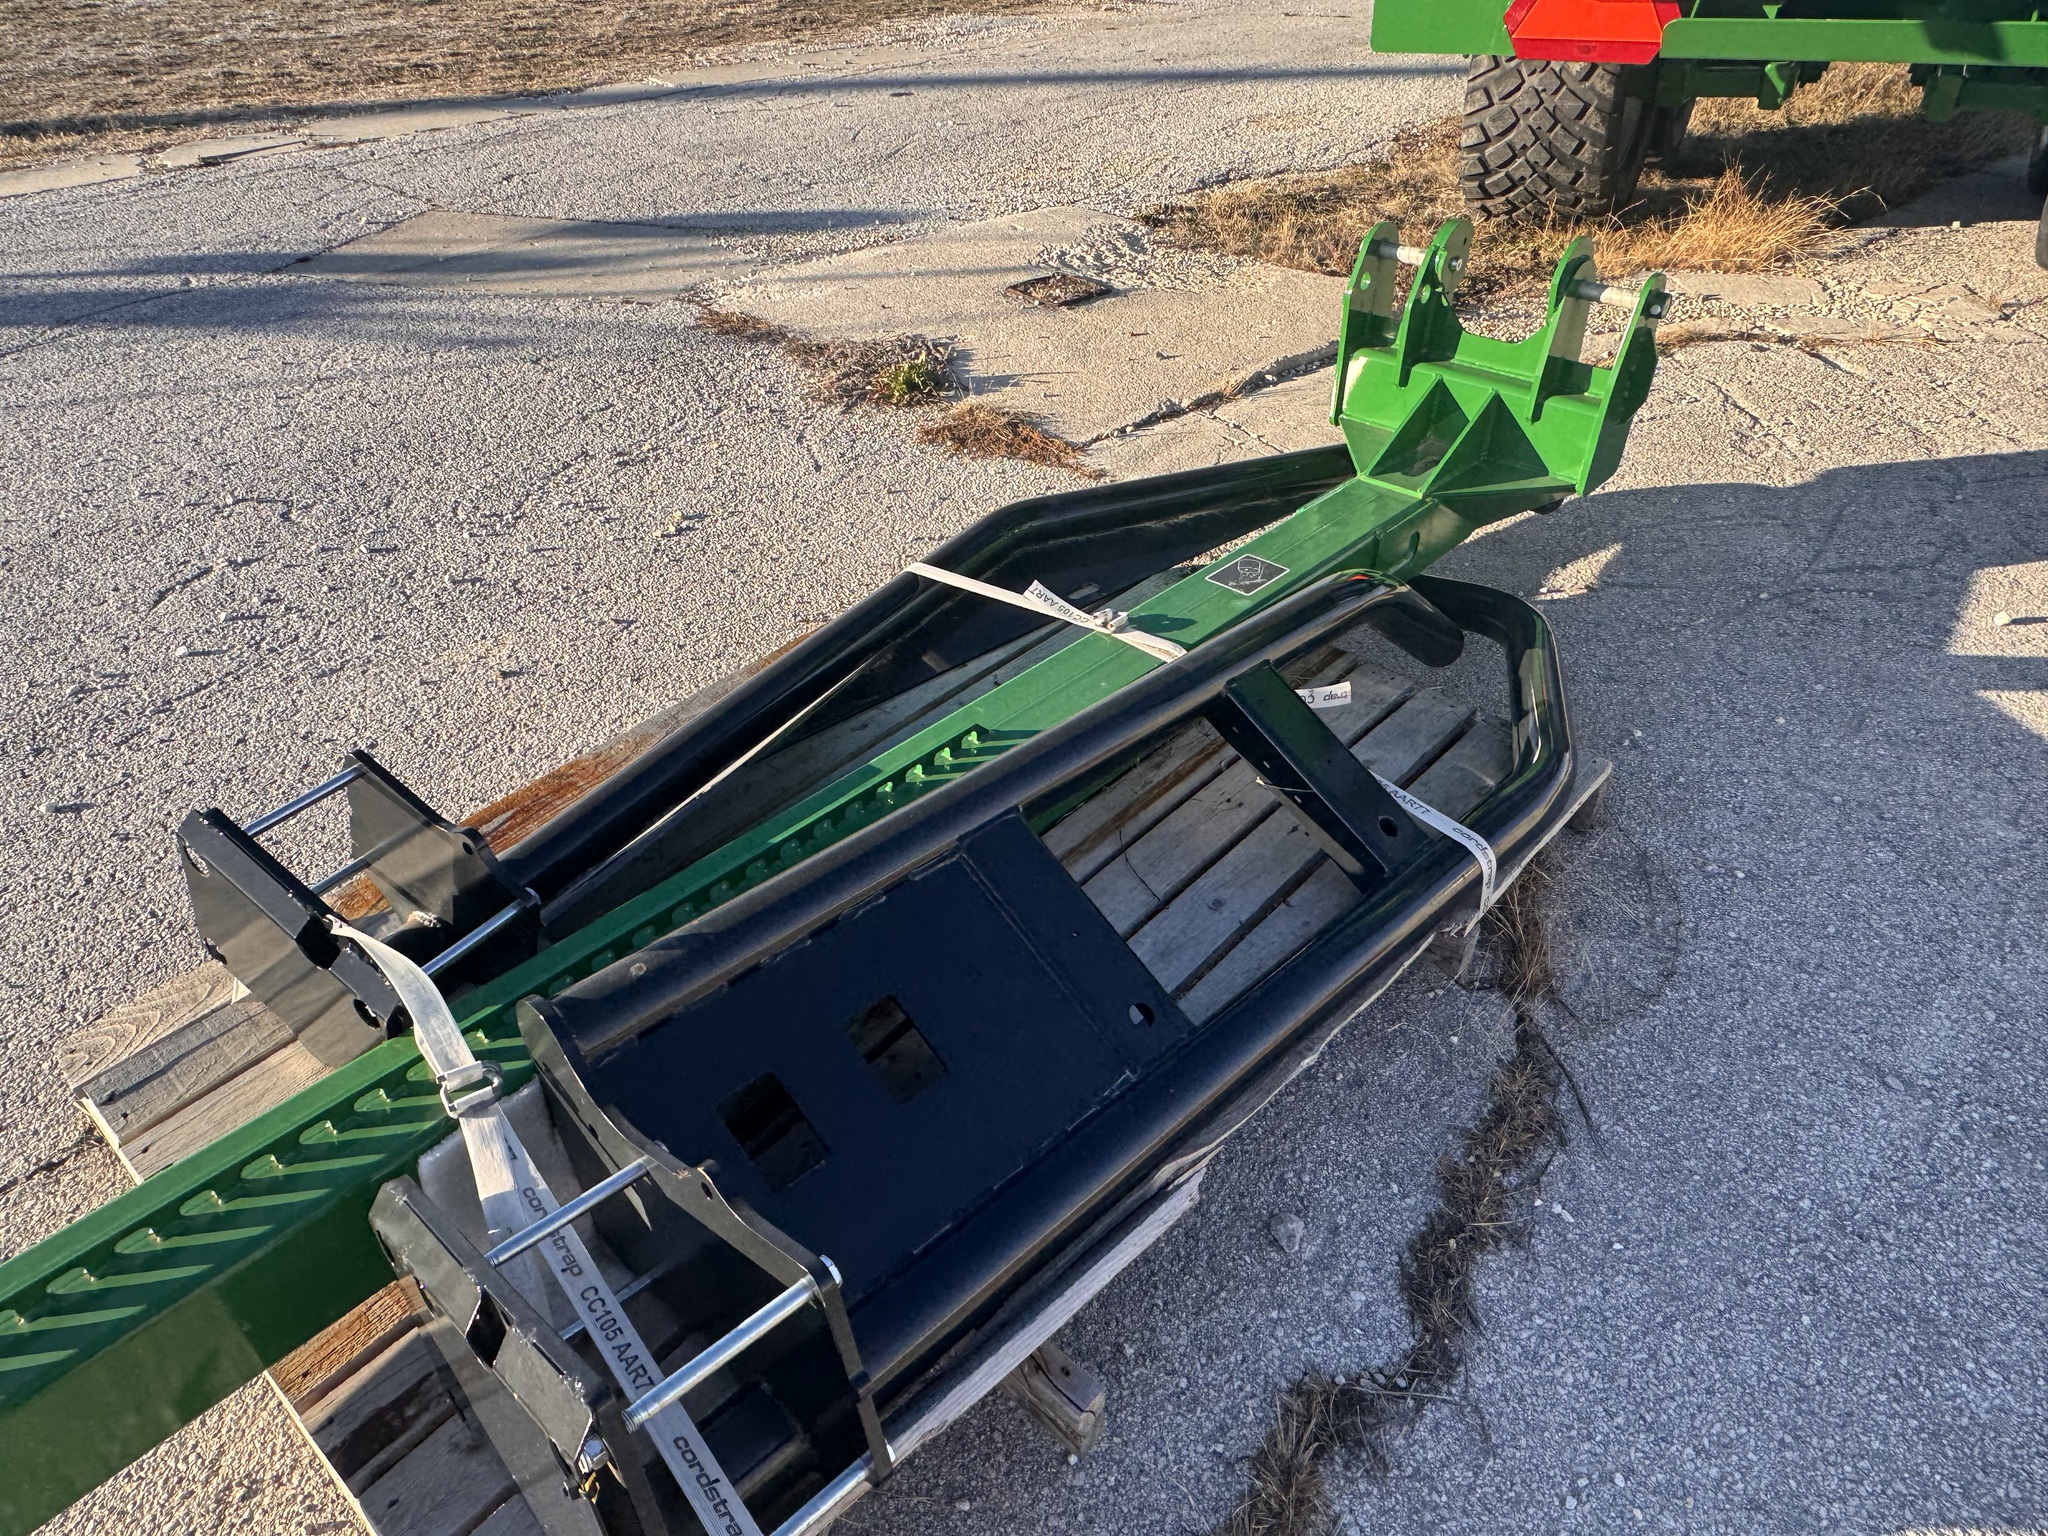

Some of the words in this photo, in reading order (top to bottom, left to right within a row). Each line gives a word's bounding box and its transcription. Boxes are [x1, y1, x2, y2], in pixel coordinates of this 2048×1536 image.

[1452, 827, 1493, 889] cordstrap
[522, 1186, 583, 1277] cortrap
[580, 1286, 625, 1342] CC105
